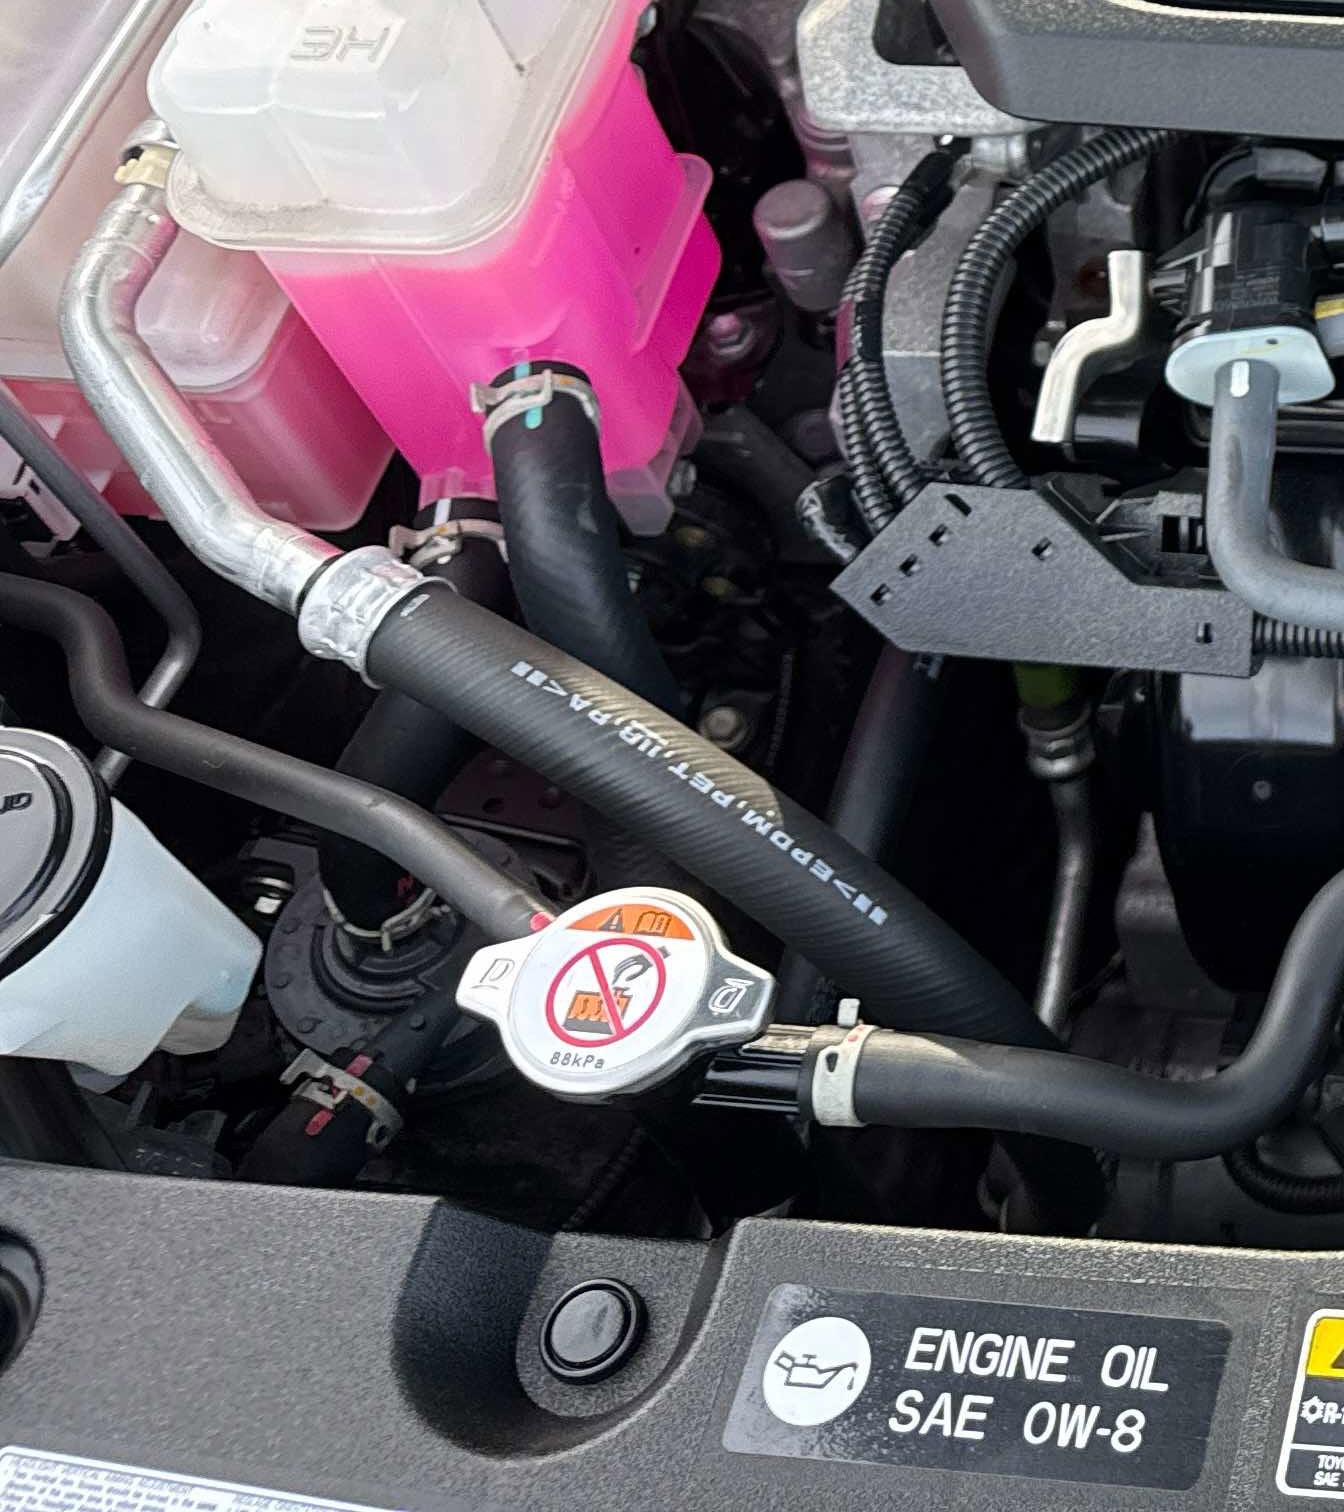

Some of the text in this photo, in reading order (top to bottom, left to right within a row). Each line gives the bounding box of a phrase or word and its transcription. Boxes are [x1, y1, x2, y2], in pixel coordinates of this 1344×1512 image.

[549, 1051, 605, 1069] 88kPa
[904, 1326, 1170, 1393] ENGINE OIL
[888, 1388, 1146, 1455] SAE 0W-8
[1313, 1471, 1340, 1488] SAE
